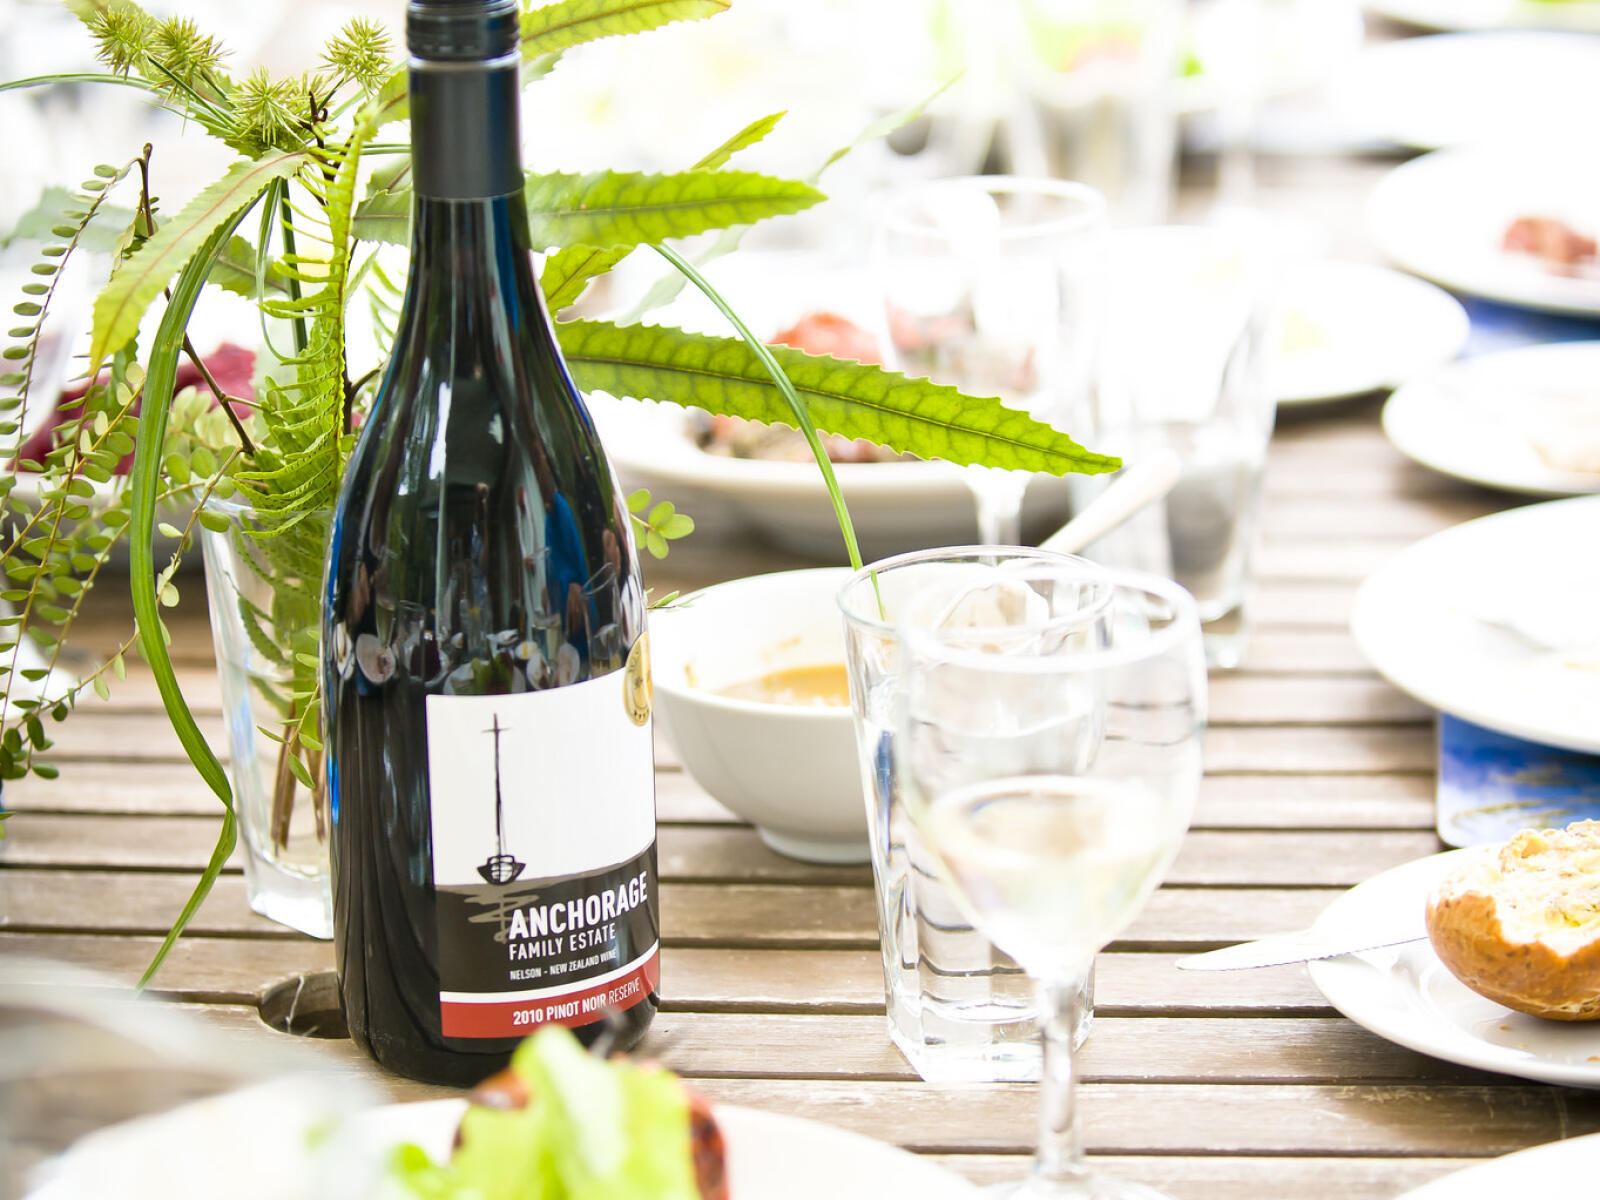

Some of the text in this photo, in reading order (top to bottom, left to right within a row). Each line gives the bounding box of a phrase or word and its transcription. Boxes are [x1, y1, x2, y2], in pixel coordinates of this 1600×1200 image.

[508, 870, 648, 940] ANCHORAGE
[508, 923, 616, 960] FAMILY ESTATE
[509, 967, 541, 980] NELSON
[549, 962, 568, 976] NEW
[568, 955, 600, 971] ZEALAND
[512, 977, 641, 1025] 2010 PINOT NOIR RESERVE
